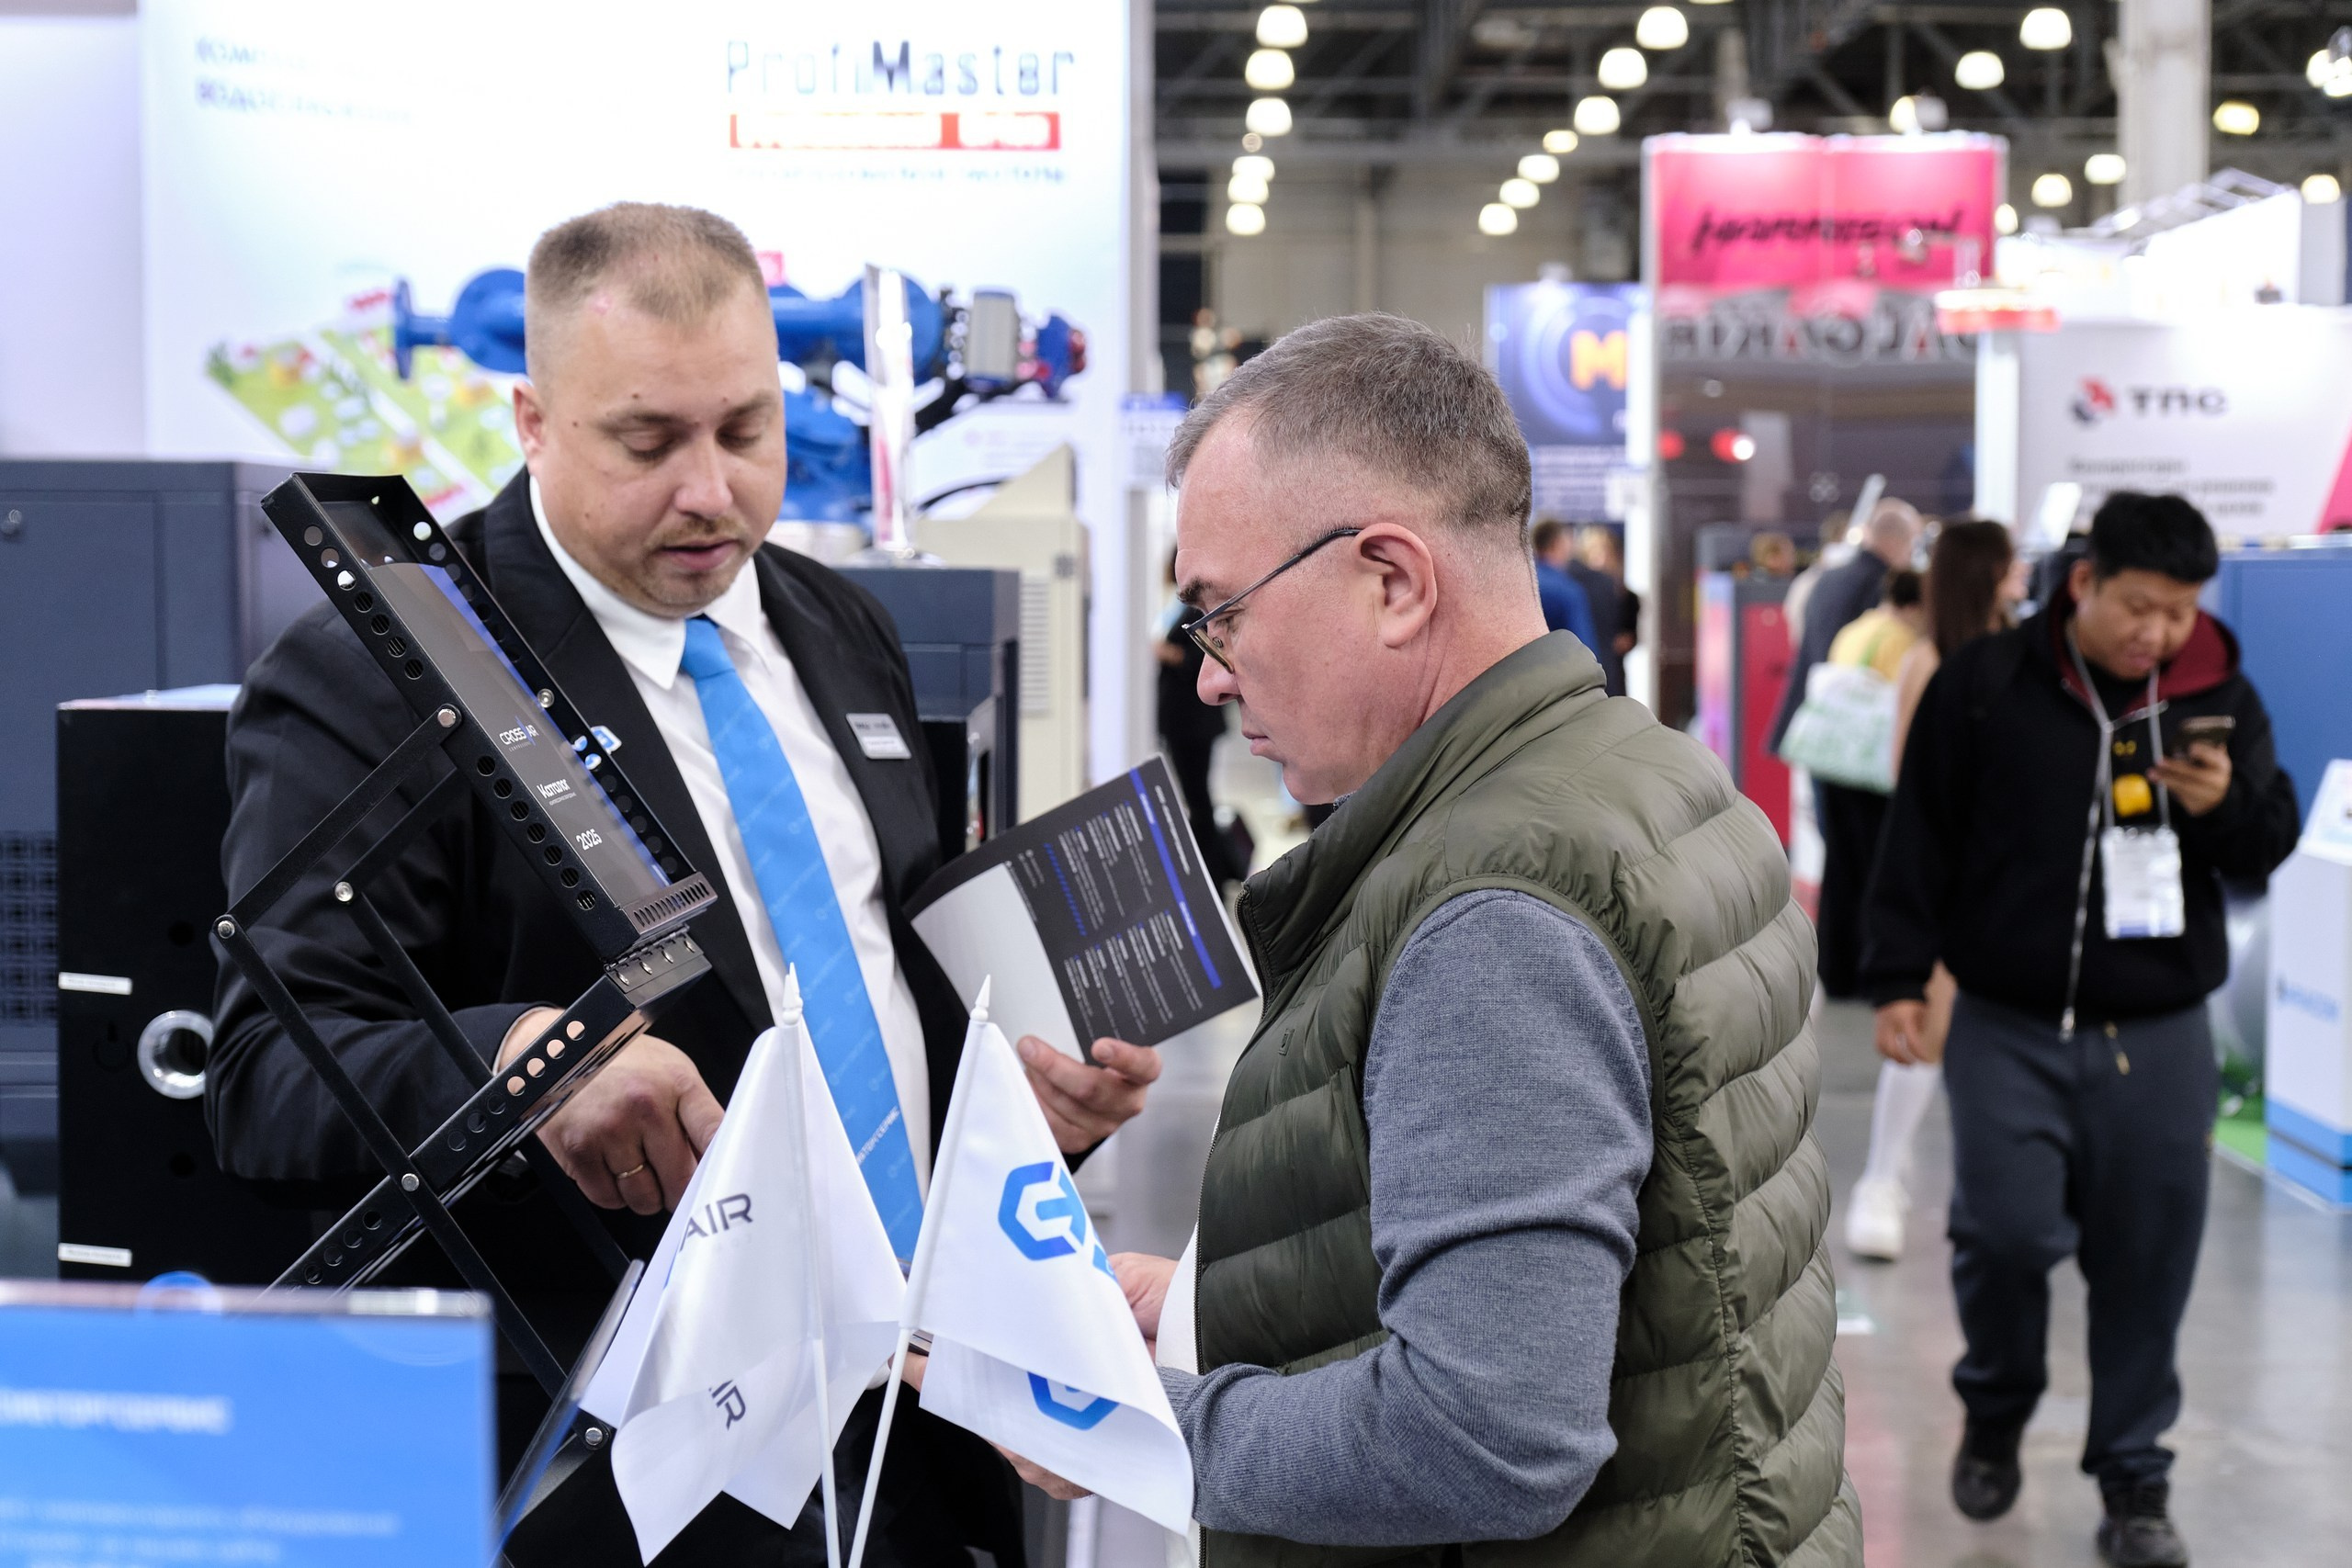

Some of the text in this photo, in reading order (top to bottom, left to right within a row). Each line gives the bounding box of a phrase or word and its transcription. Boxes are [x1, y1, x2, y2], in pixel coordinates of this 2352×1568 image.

[537, 779, 571, 799] Каталог
[576, 829, 603, 851] 2025
[679, 1193, 753, 1253] AIR
[708, 1379, 746, 1431] IR
